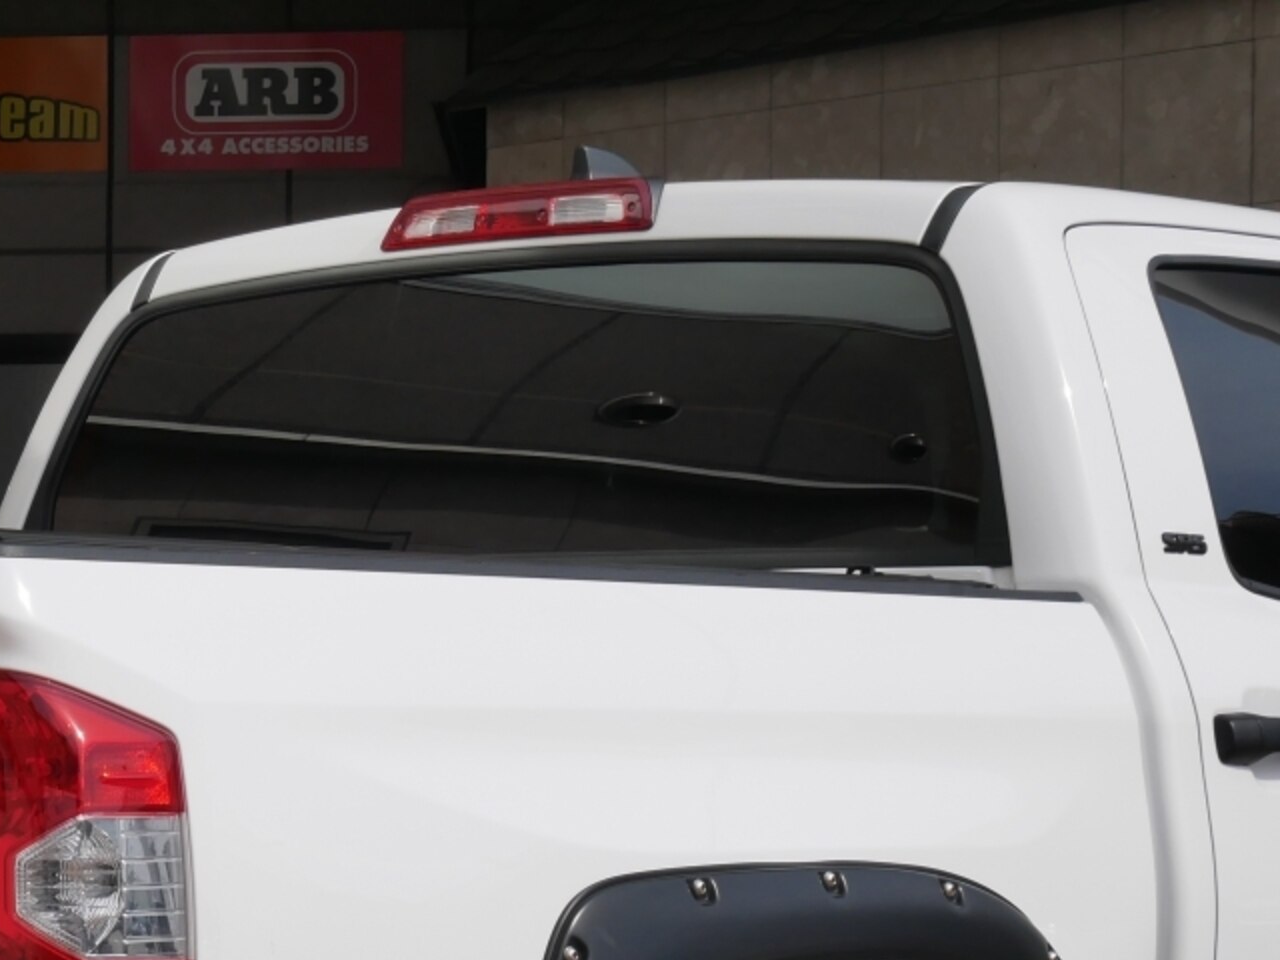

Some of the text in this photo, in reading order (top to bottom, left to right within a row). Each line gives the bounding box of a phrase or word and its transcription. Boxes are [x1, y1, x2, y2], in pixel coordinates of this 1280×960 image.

[193, 67, 340, 118] ARB
[160, 135, 370, 156] 4X4 ACCESSORIES
